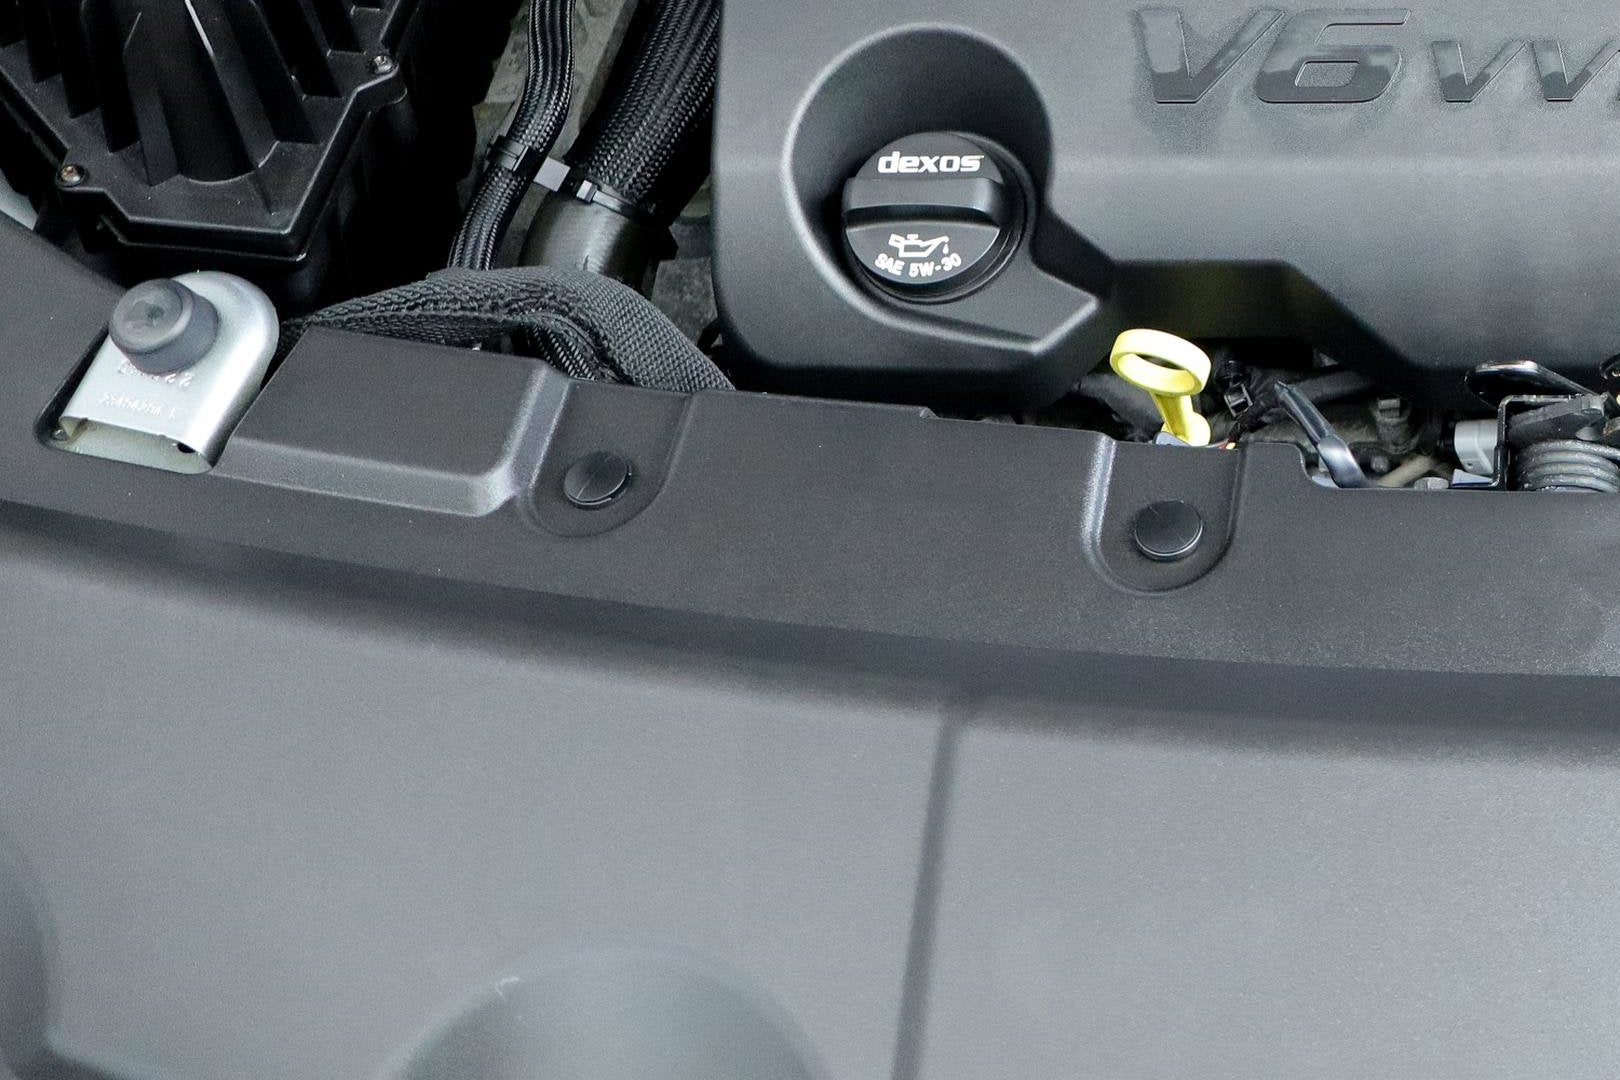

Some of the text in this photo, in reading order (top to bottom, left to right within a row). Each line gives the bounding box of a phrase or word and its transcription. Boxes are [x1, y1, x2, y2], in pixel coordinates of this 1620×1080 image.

[1136, 7, 1412, 104] V6
[877, 151, 985, 173] dexos
[874, 253, 962, 278] SAE 5W-30
